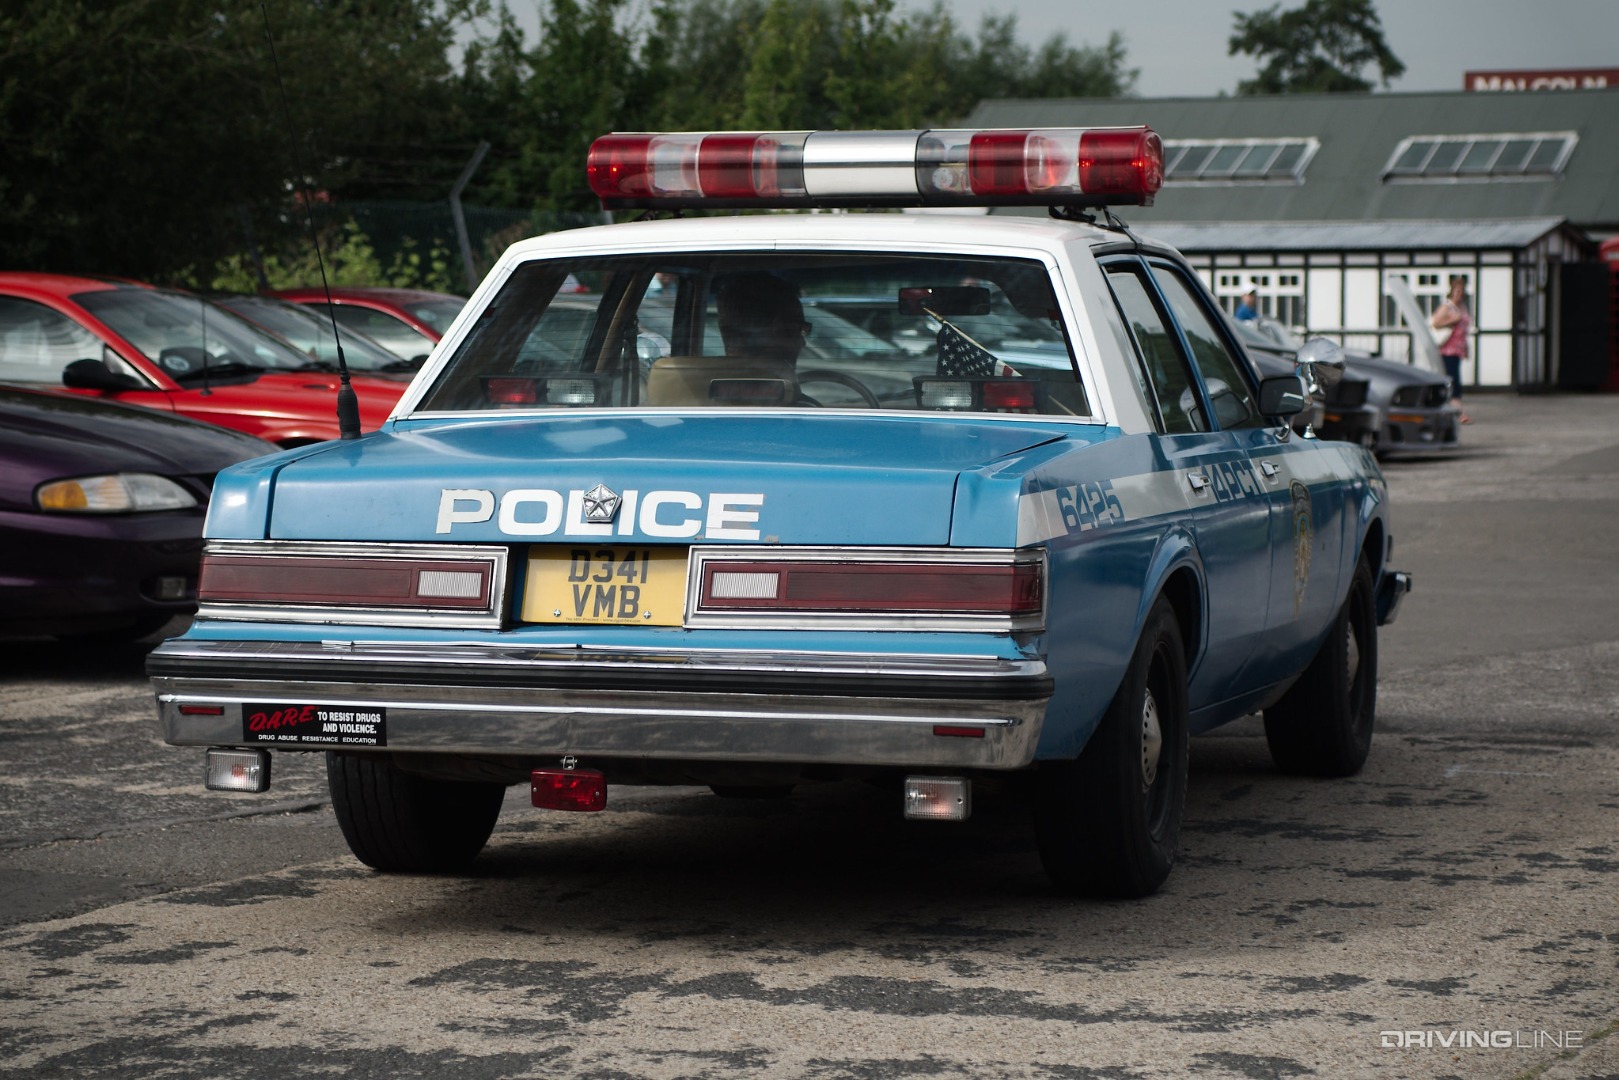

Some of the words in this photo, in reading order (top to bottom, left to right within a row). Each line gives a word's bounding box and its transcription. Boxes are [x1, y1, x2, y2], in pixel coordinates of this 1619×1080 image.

[436, 489, 764, 540] POLICE
[1056, 481, 1125, 534] 6425
[568, 550, 650, 584] D341
[572, 584, 641, 618] VMB
[317, 711, 328, 721] TO
[329, 712, 355, 722] RESIST
[355, 712, 381, 723] DRUGS
[322, 723, 338, 733] AND
[339, 723, 377, 734] VIOLENCE.
[302, 735, 338, 743] RESISTANCE
